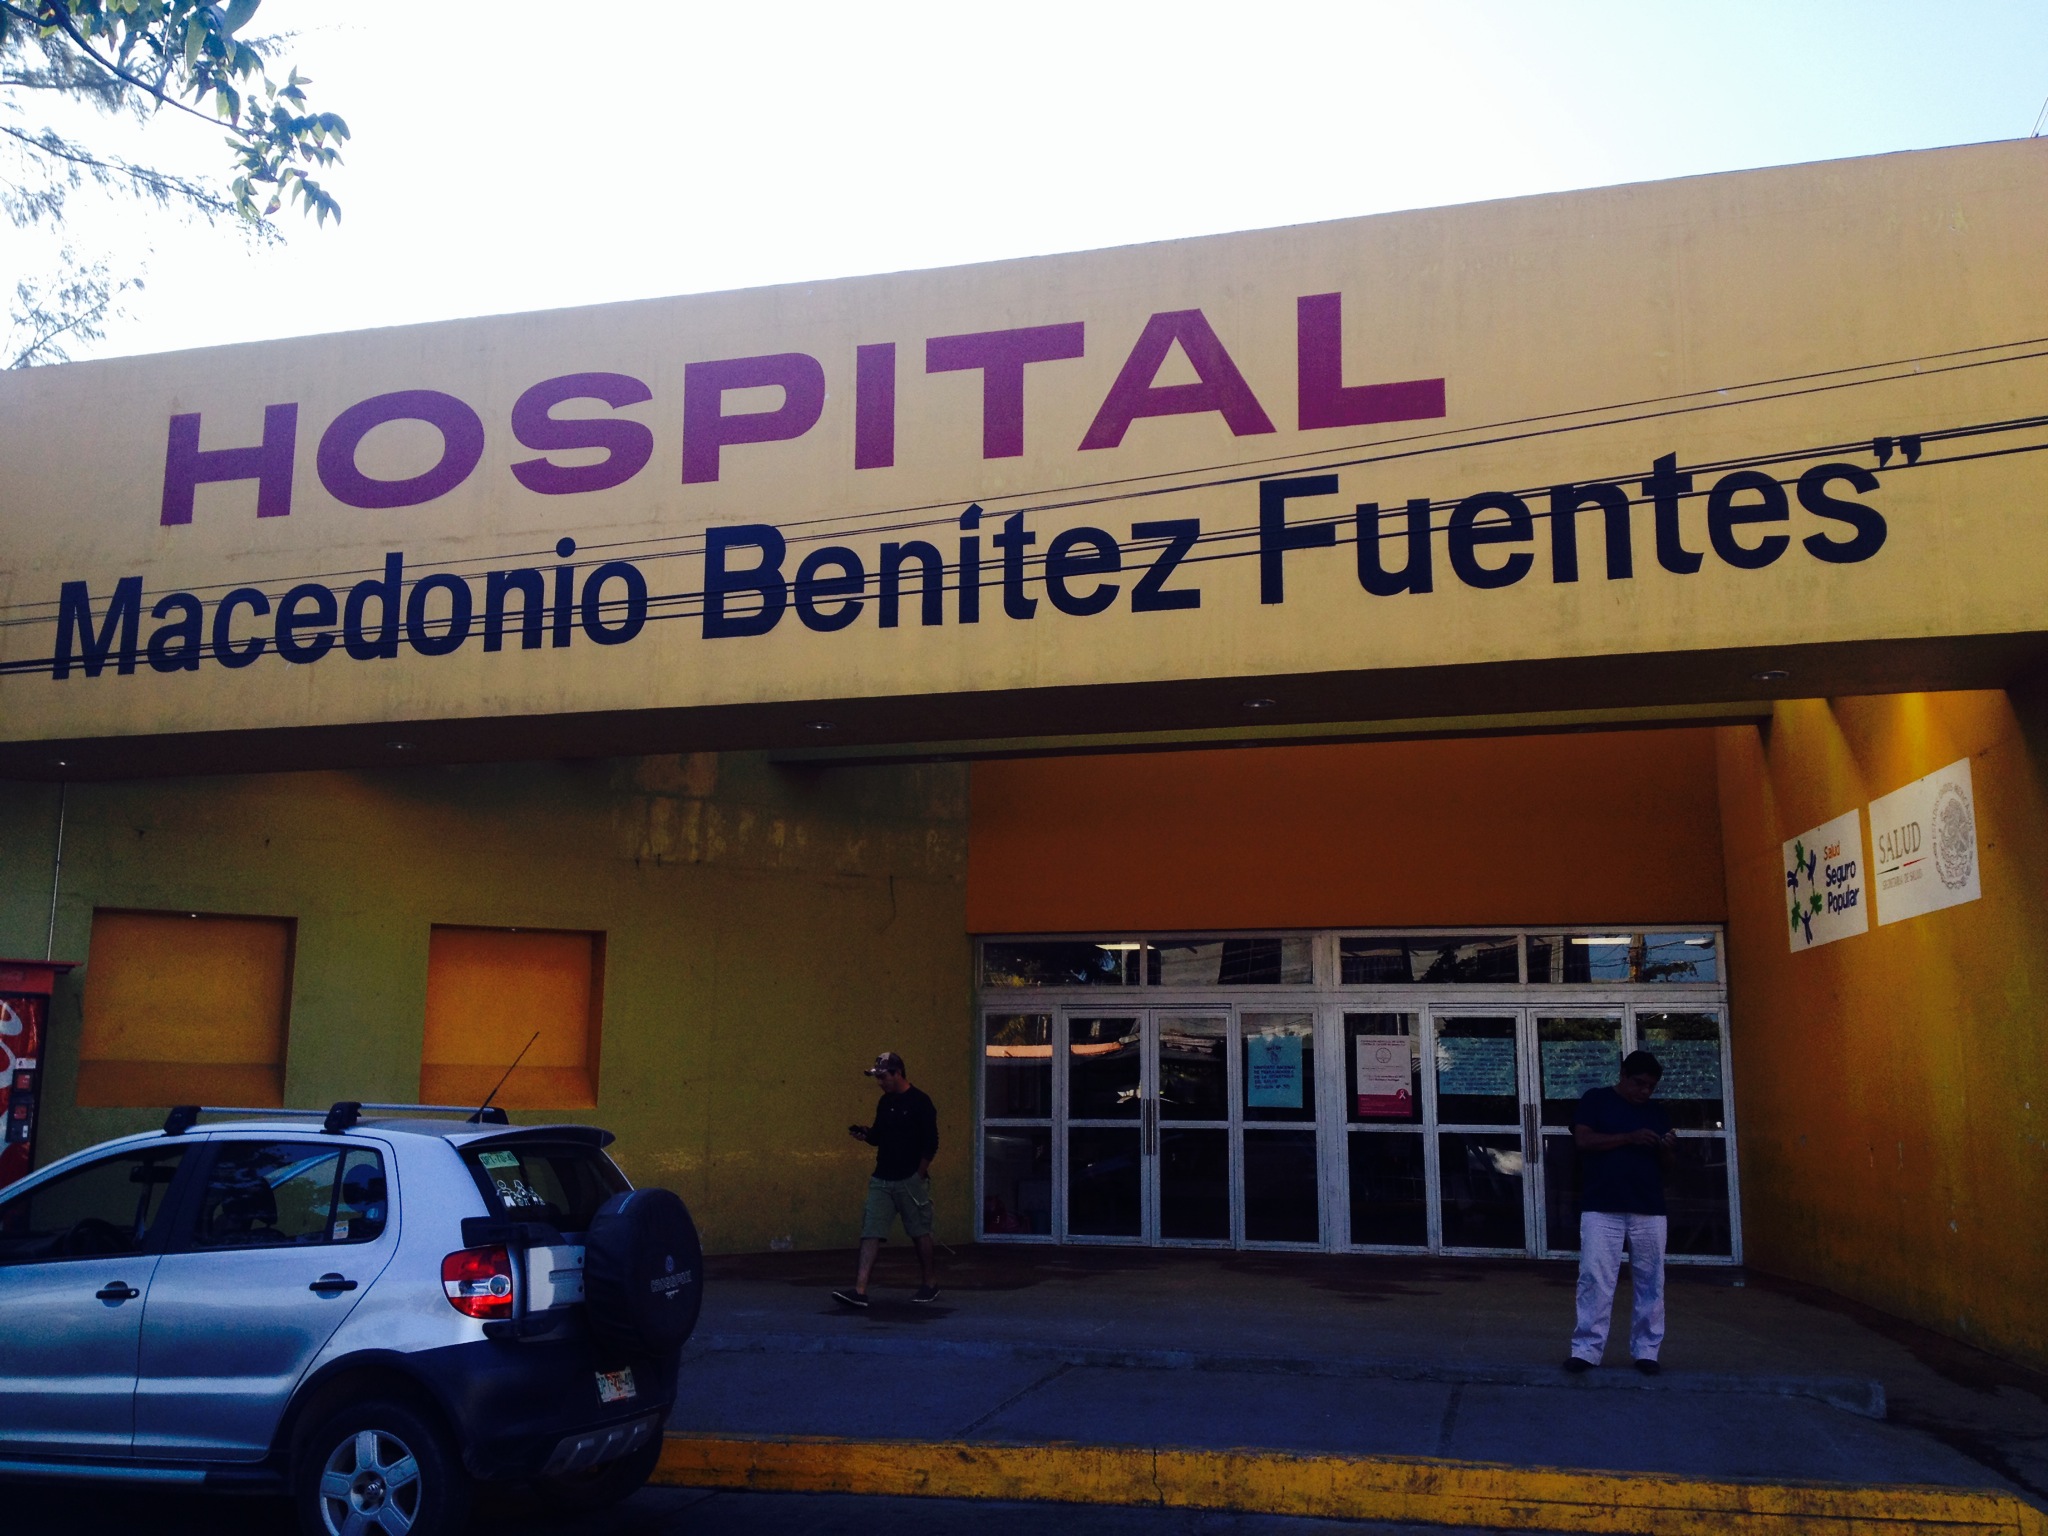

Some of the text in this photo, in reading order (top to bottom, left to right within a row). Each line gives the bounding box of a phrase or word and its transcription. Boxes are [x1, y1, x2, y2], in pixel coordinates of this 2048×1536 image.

[160, 292, 1446, 526] HOSPITAL
[52, 536, 649, 680] Macedonio
[1878, 821, 1922, 864] SALUD
[1825, 860, 1857, 889] Seguro
[1827, 884, 1860, 916] Popular
